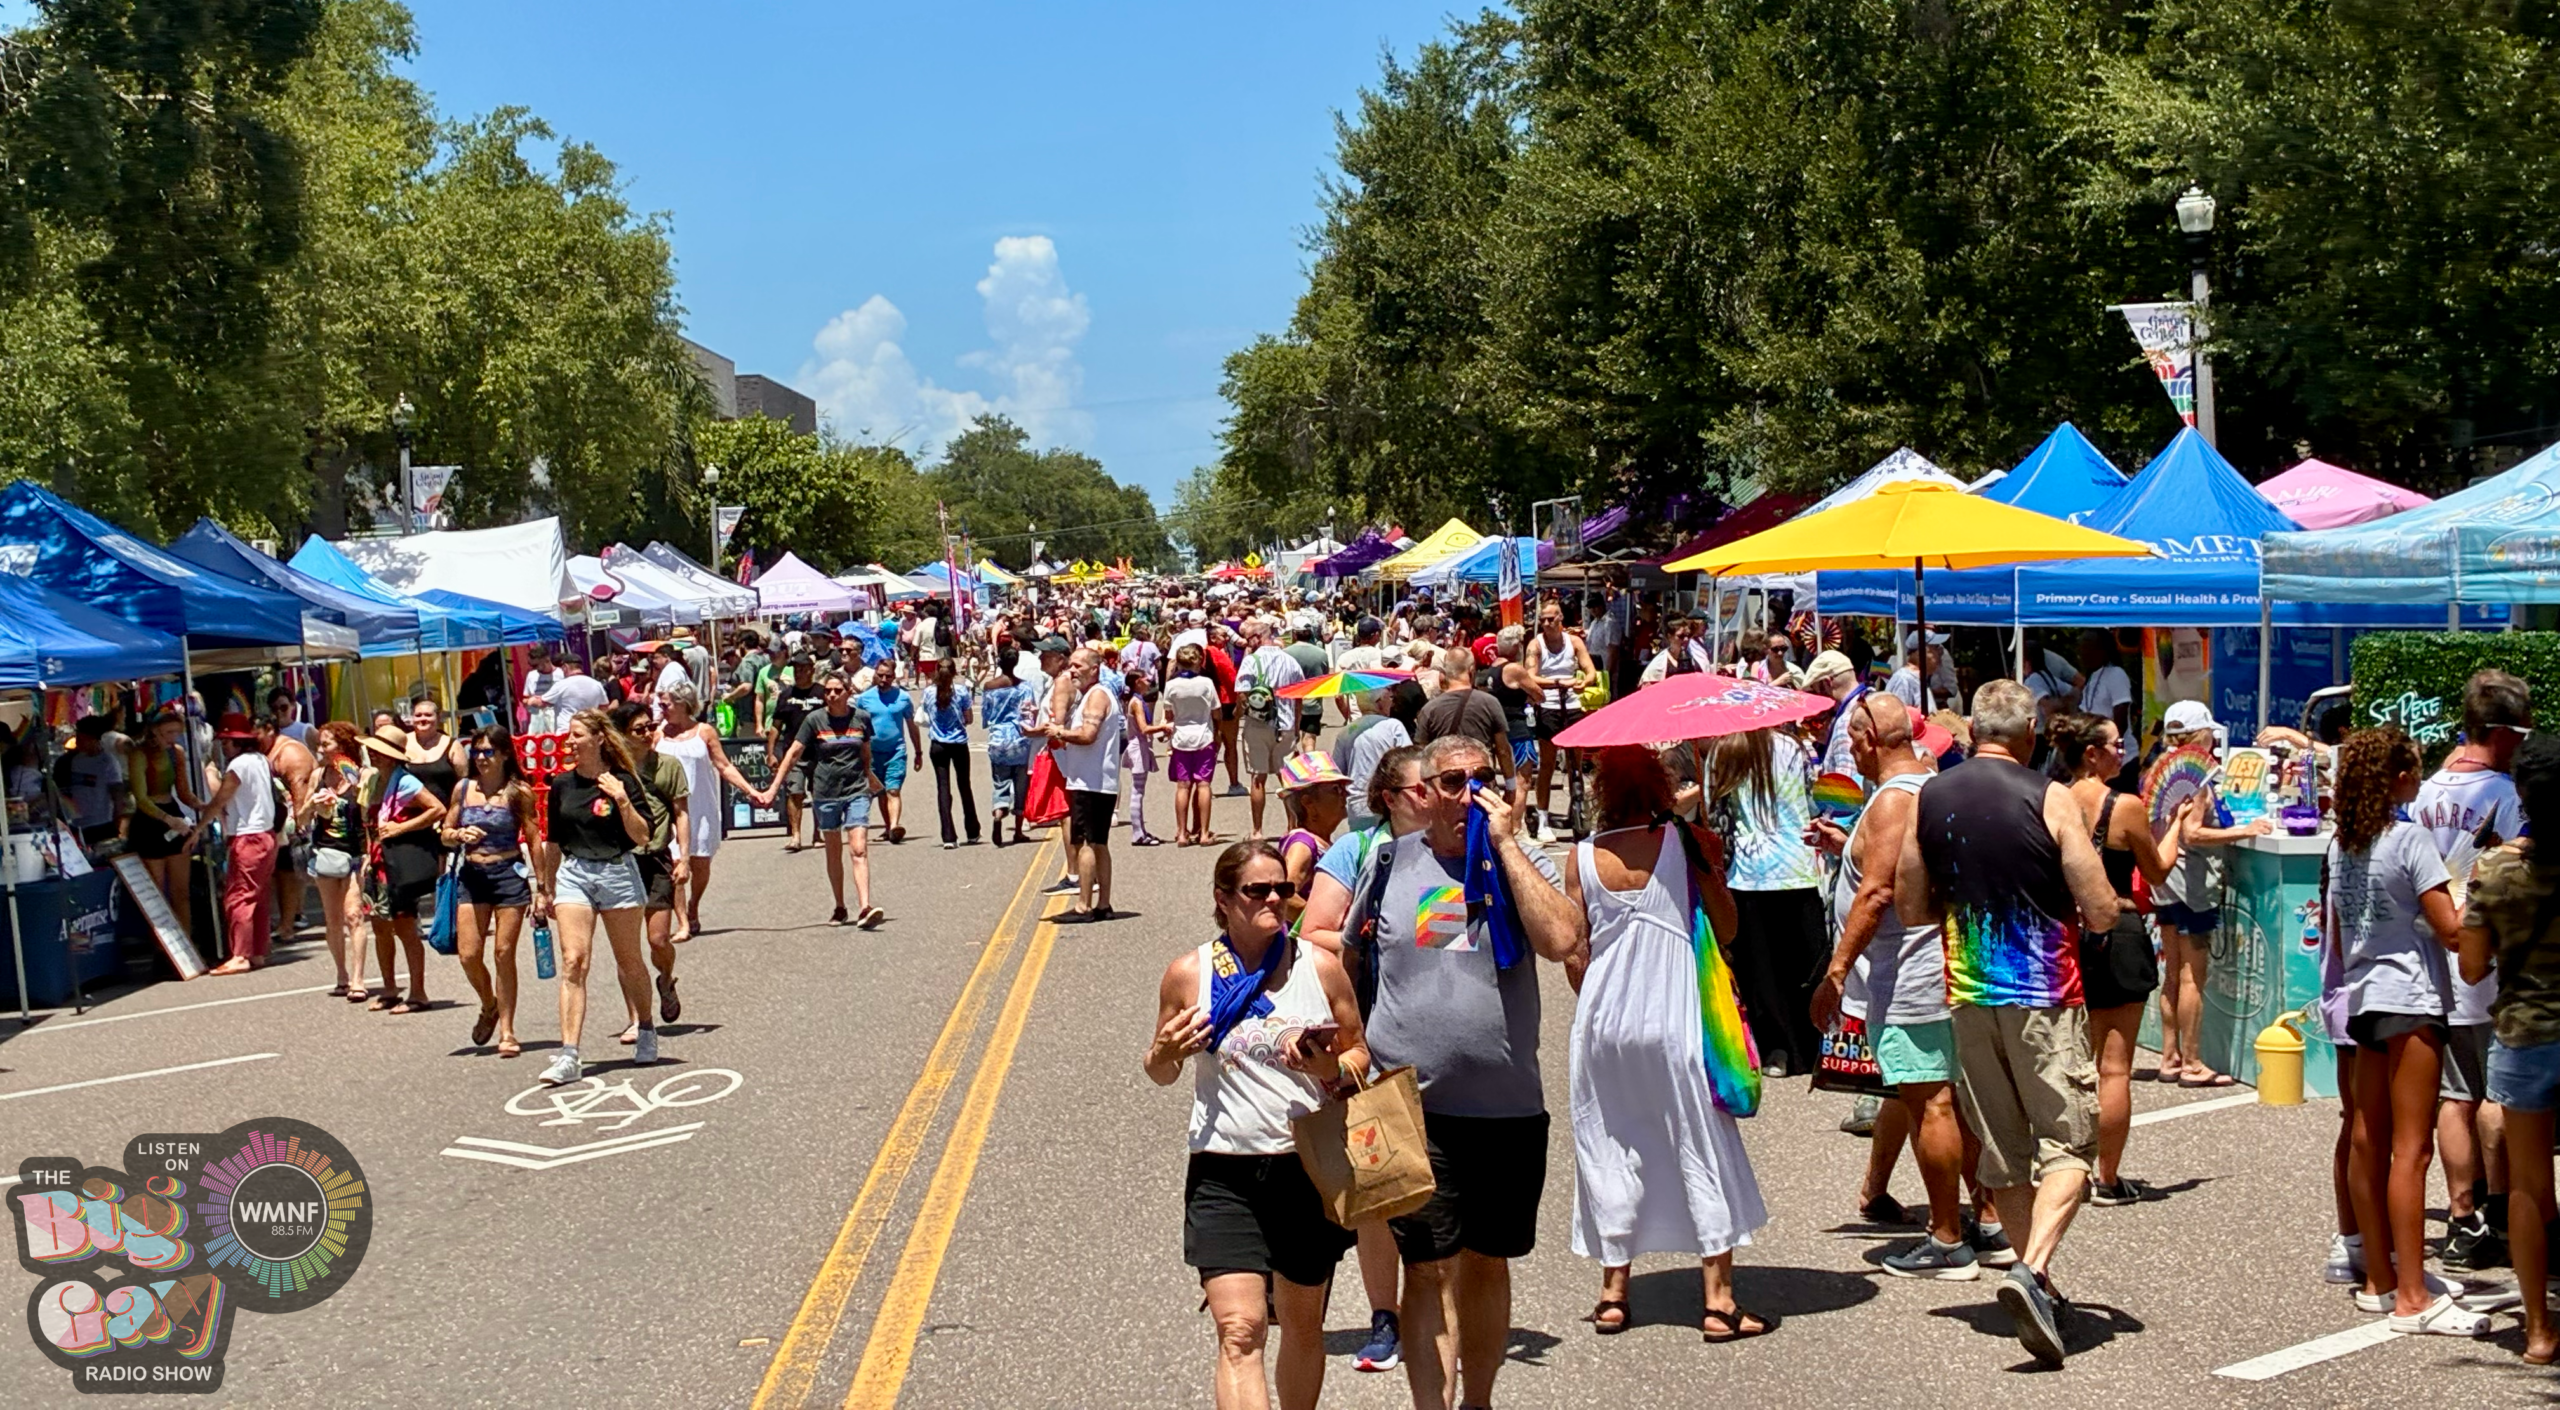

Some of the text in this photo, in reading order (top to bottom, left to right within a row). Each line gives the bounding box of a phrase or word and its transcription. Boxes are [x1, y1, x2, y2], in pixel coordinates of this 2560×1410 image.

[2036, 593, 2085, 606] Primary
[2090, 593, 2119, 605] Care
[2130, 593, 2172, 605] Sexual
[2175, 593, 2218, 605] Health
[2220, 593, 2230, 605] &
[2226, 757, 2265, 777] BEST
